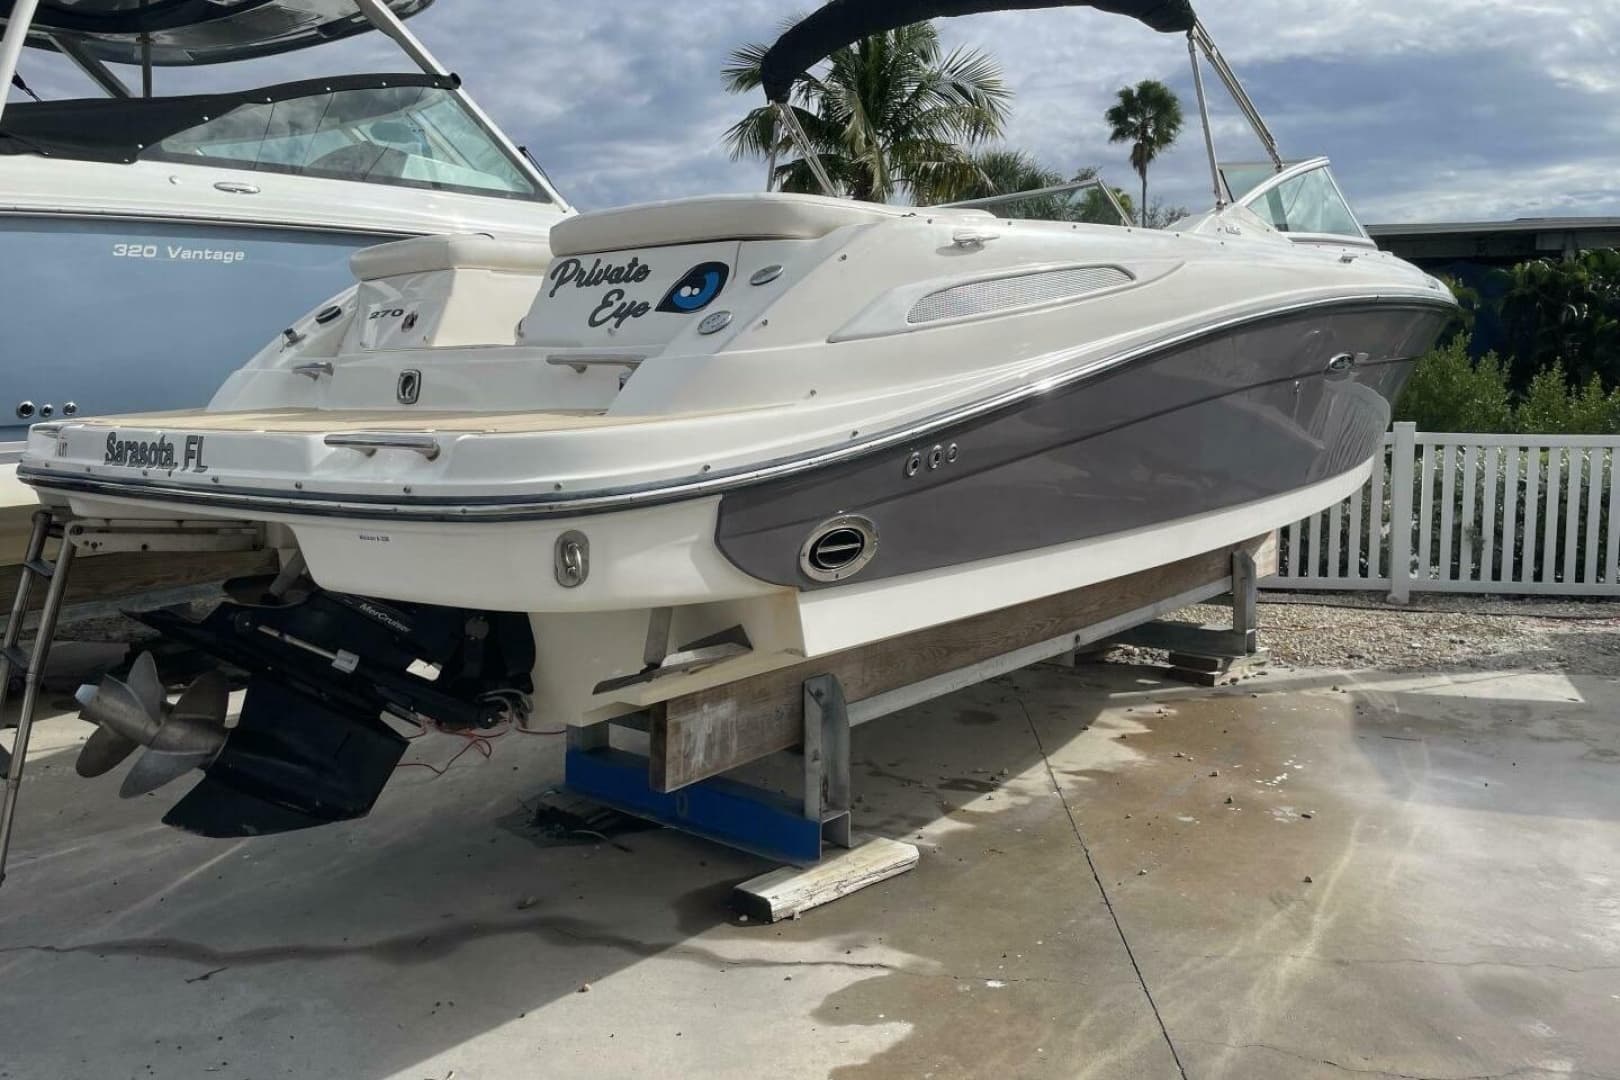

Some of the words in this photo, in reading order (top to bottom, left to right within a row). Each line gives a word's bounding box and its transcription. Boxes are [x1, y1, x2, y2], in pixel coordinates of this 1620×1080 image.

[112, 243, 158, 258] 320
[167, 245, 246, 263] Vantage
[550, 257, 651, 298] Private
[368, 308, 404, 320] 270
[588, 288, 651, 329] Eye
[181, 434, 209, 473] FL
